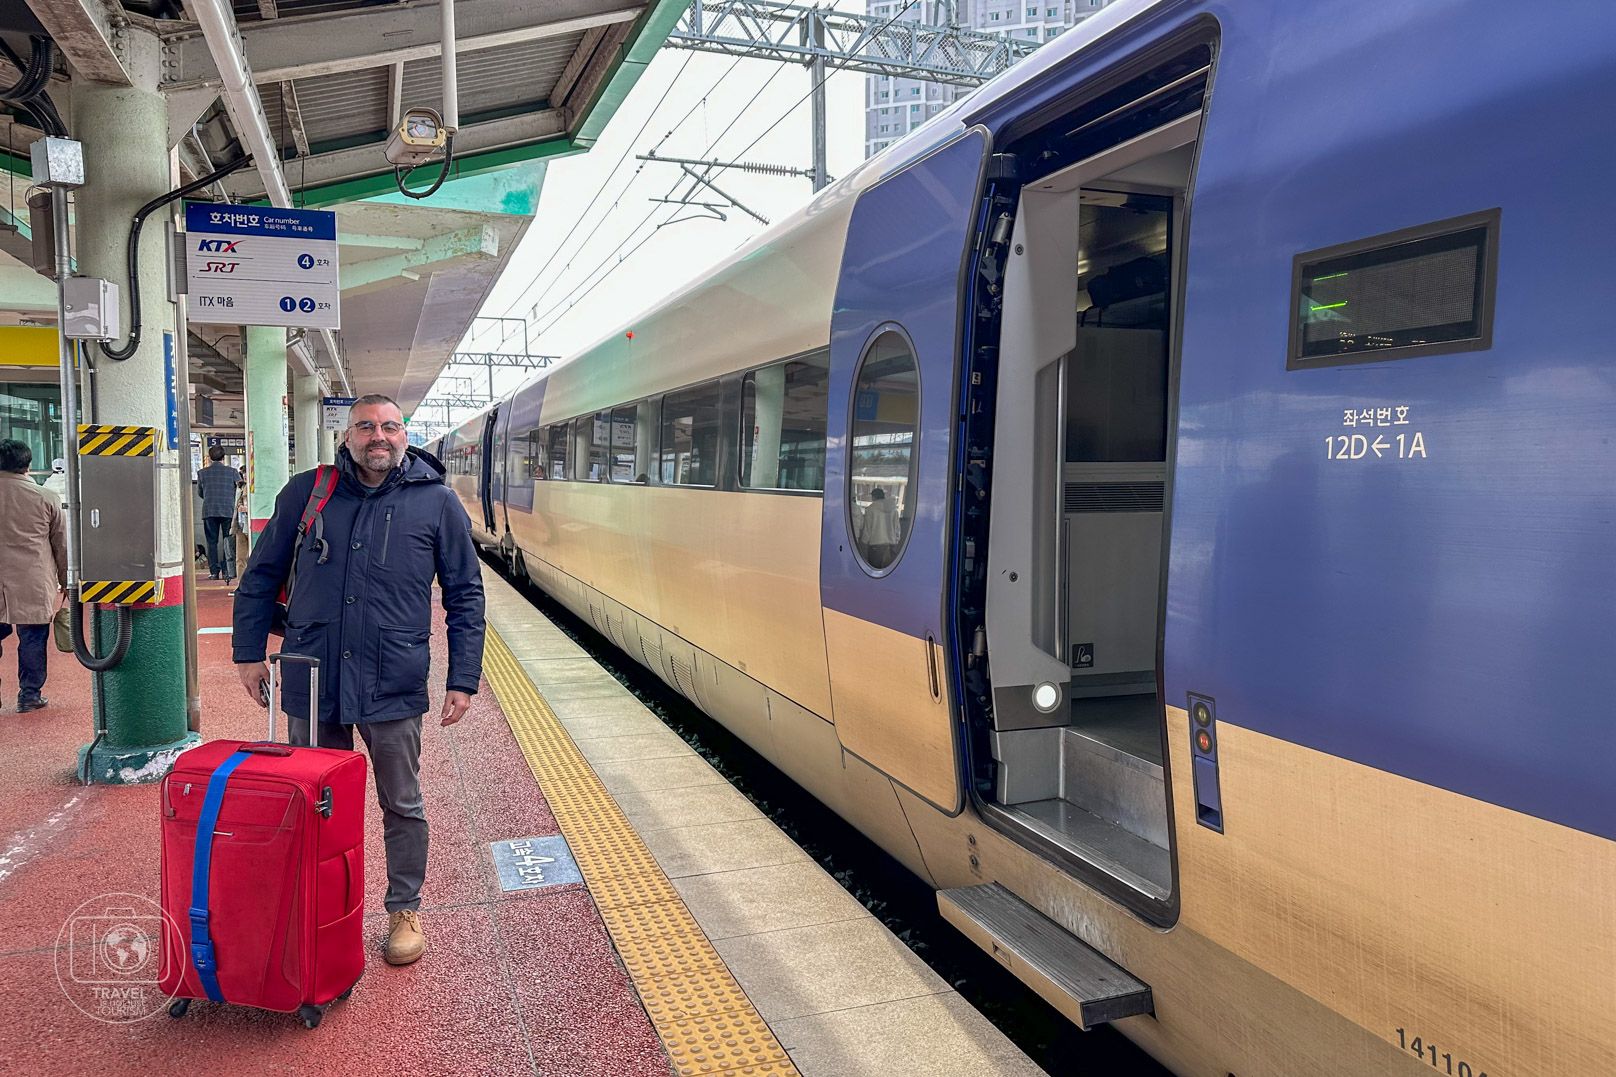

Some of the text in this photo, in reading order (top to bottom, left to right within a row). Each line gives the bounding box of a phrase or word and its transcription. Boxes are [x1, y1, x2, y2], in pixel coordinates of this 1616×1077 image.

[209, 212, 260, 228] 호차번호
[263, 216, 300, 225] Car number
[198, 239, 247, 253] KTX
[198, 261, 240, 274] SRT
[316, 258, 330, 267] 호차
[199, 296, 234, 308] ITX 마음
[317, 302, 331, 310] 호차
[1343, 405, 1410, 428] 좌석번호
[211, 438, 217, 446] 5
[1396, 1028, 1488, 1077] 14110
